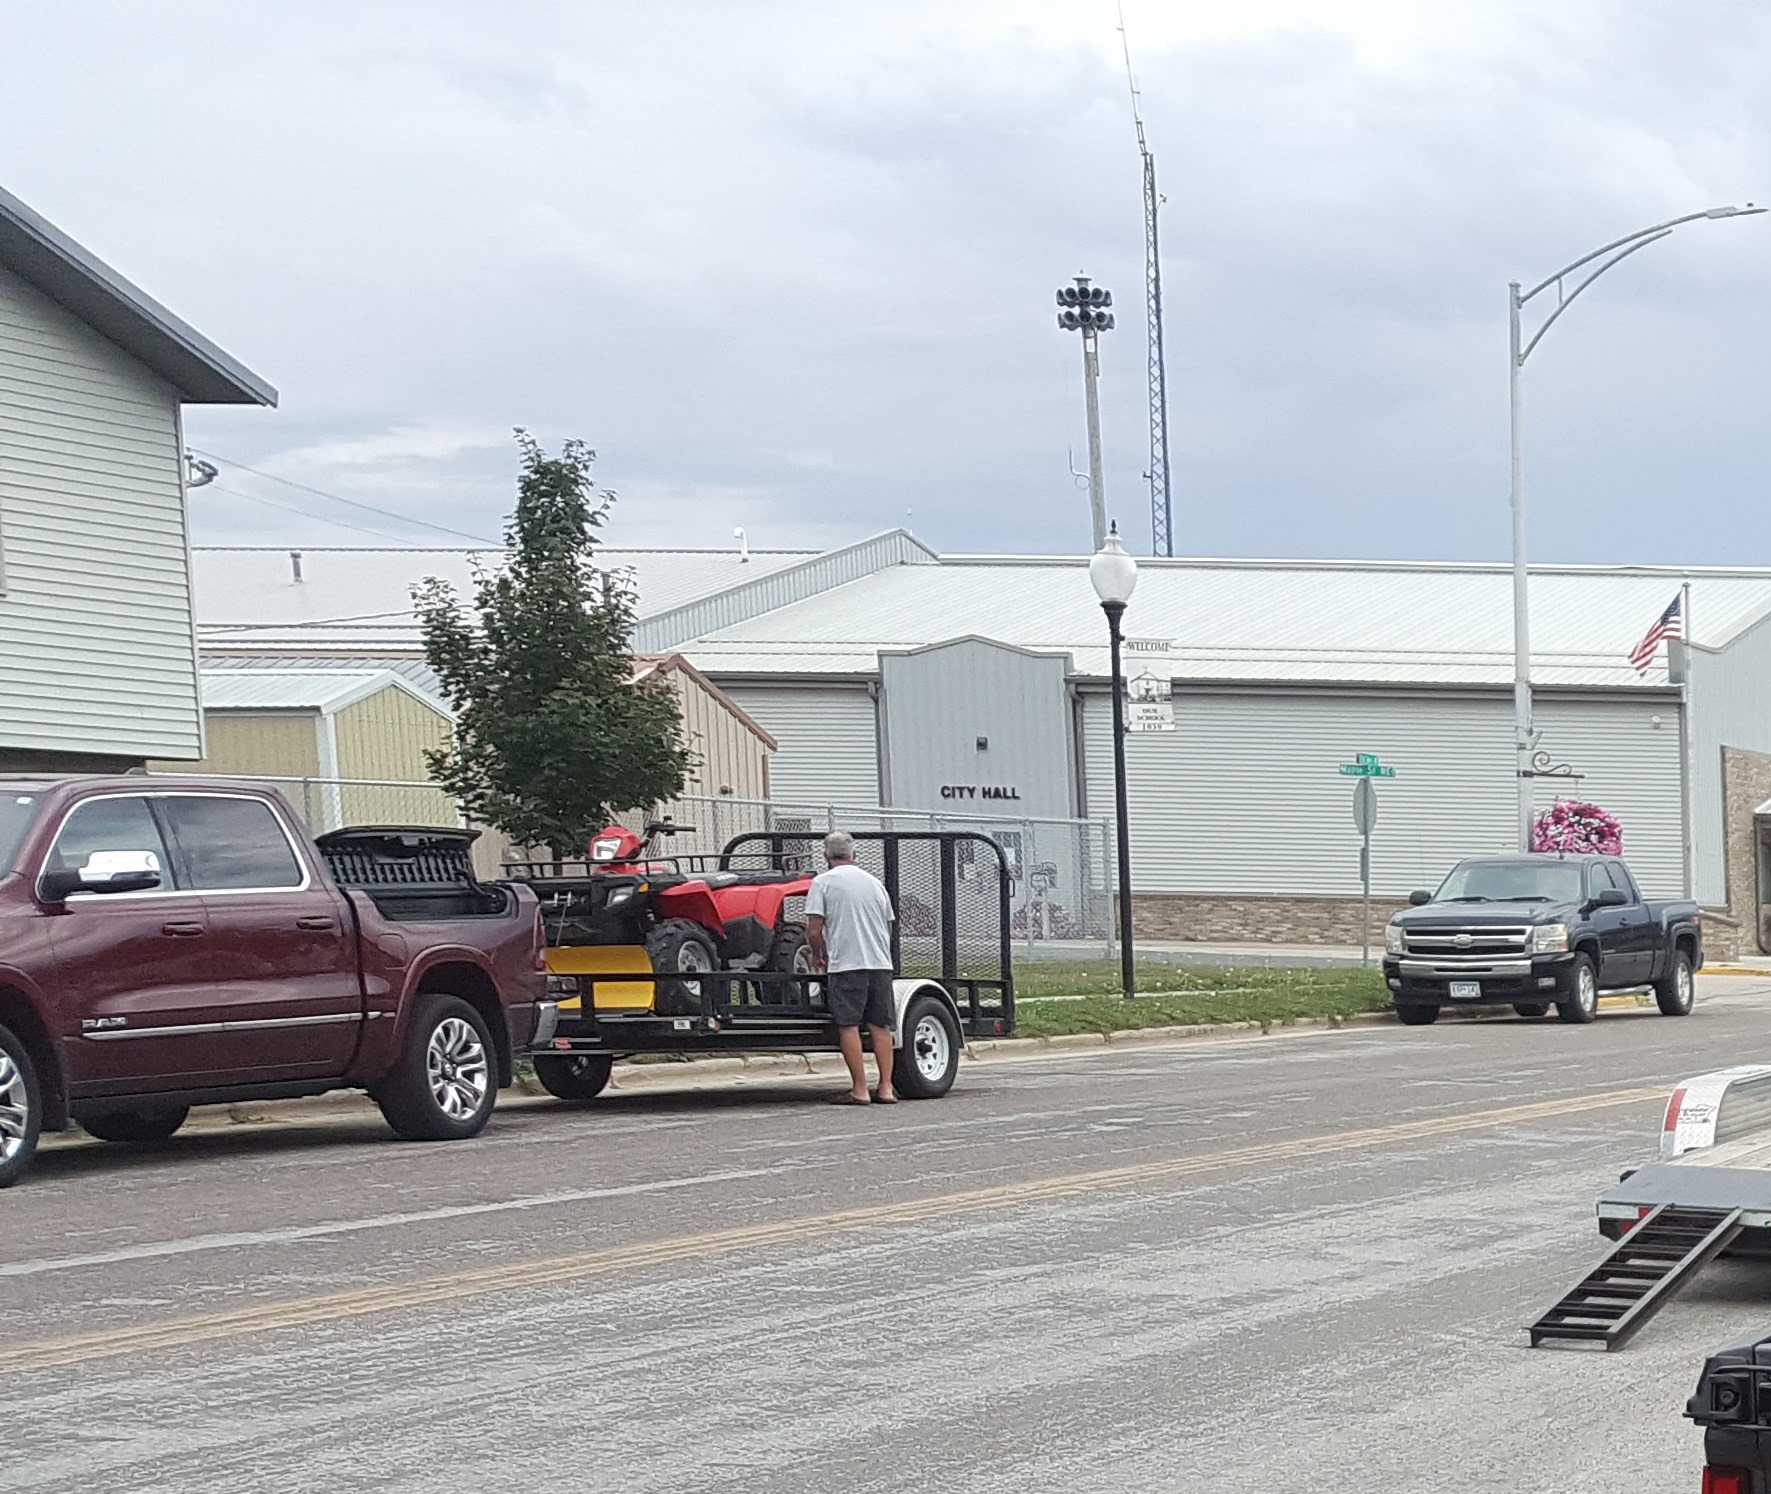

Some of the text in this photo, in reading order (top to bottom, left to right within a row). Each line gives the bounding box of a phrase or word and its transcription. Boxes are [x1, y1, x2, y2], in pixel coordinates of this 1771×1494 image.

[1127, 641, 1170, 652] WELCOME
[940, 785, 1021, 800] CITY HALL
[82, 1016, 127, 1029] RAM
